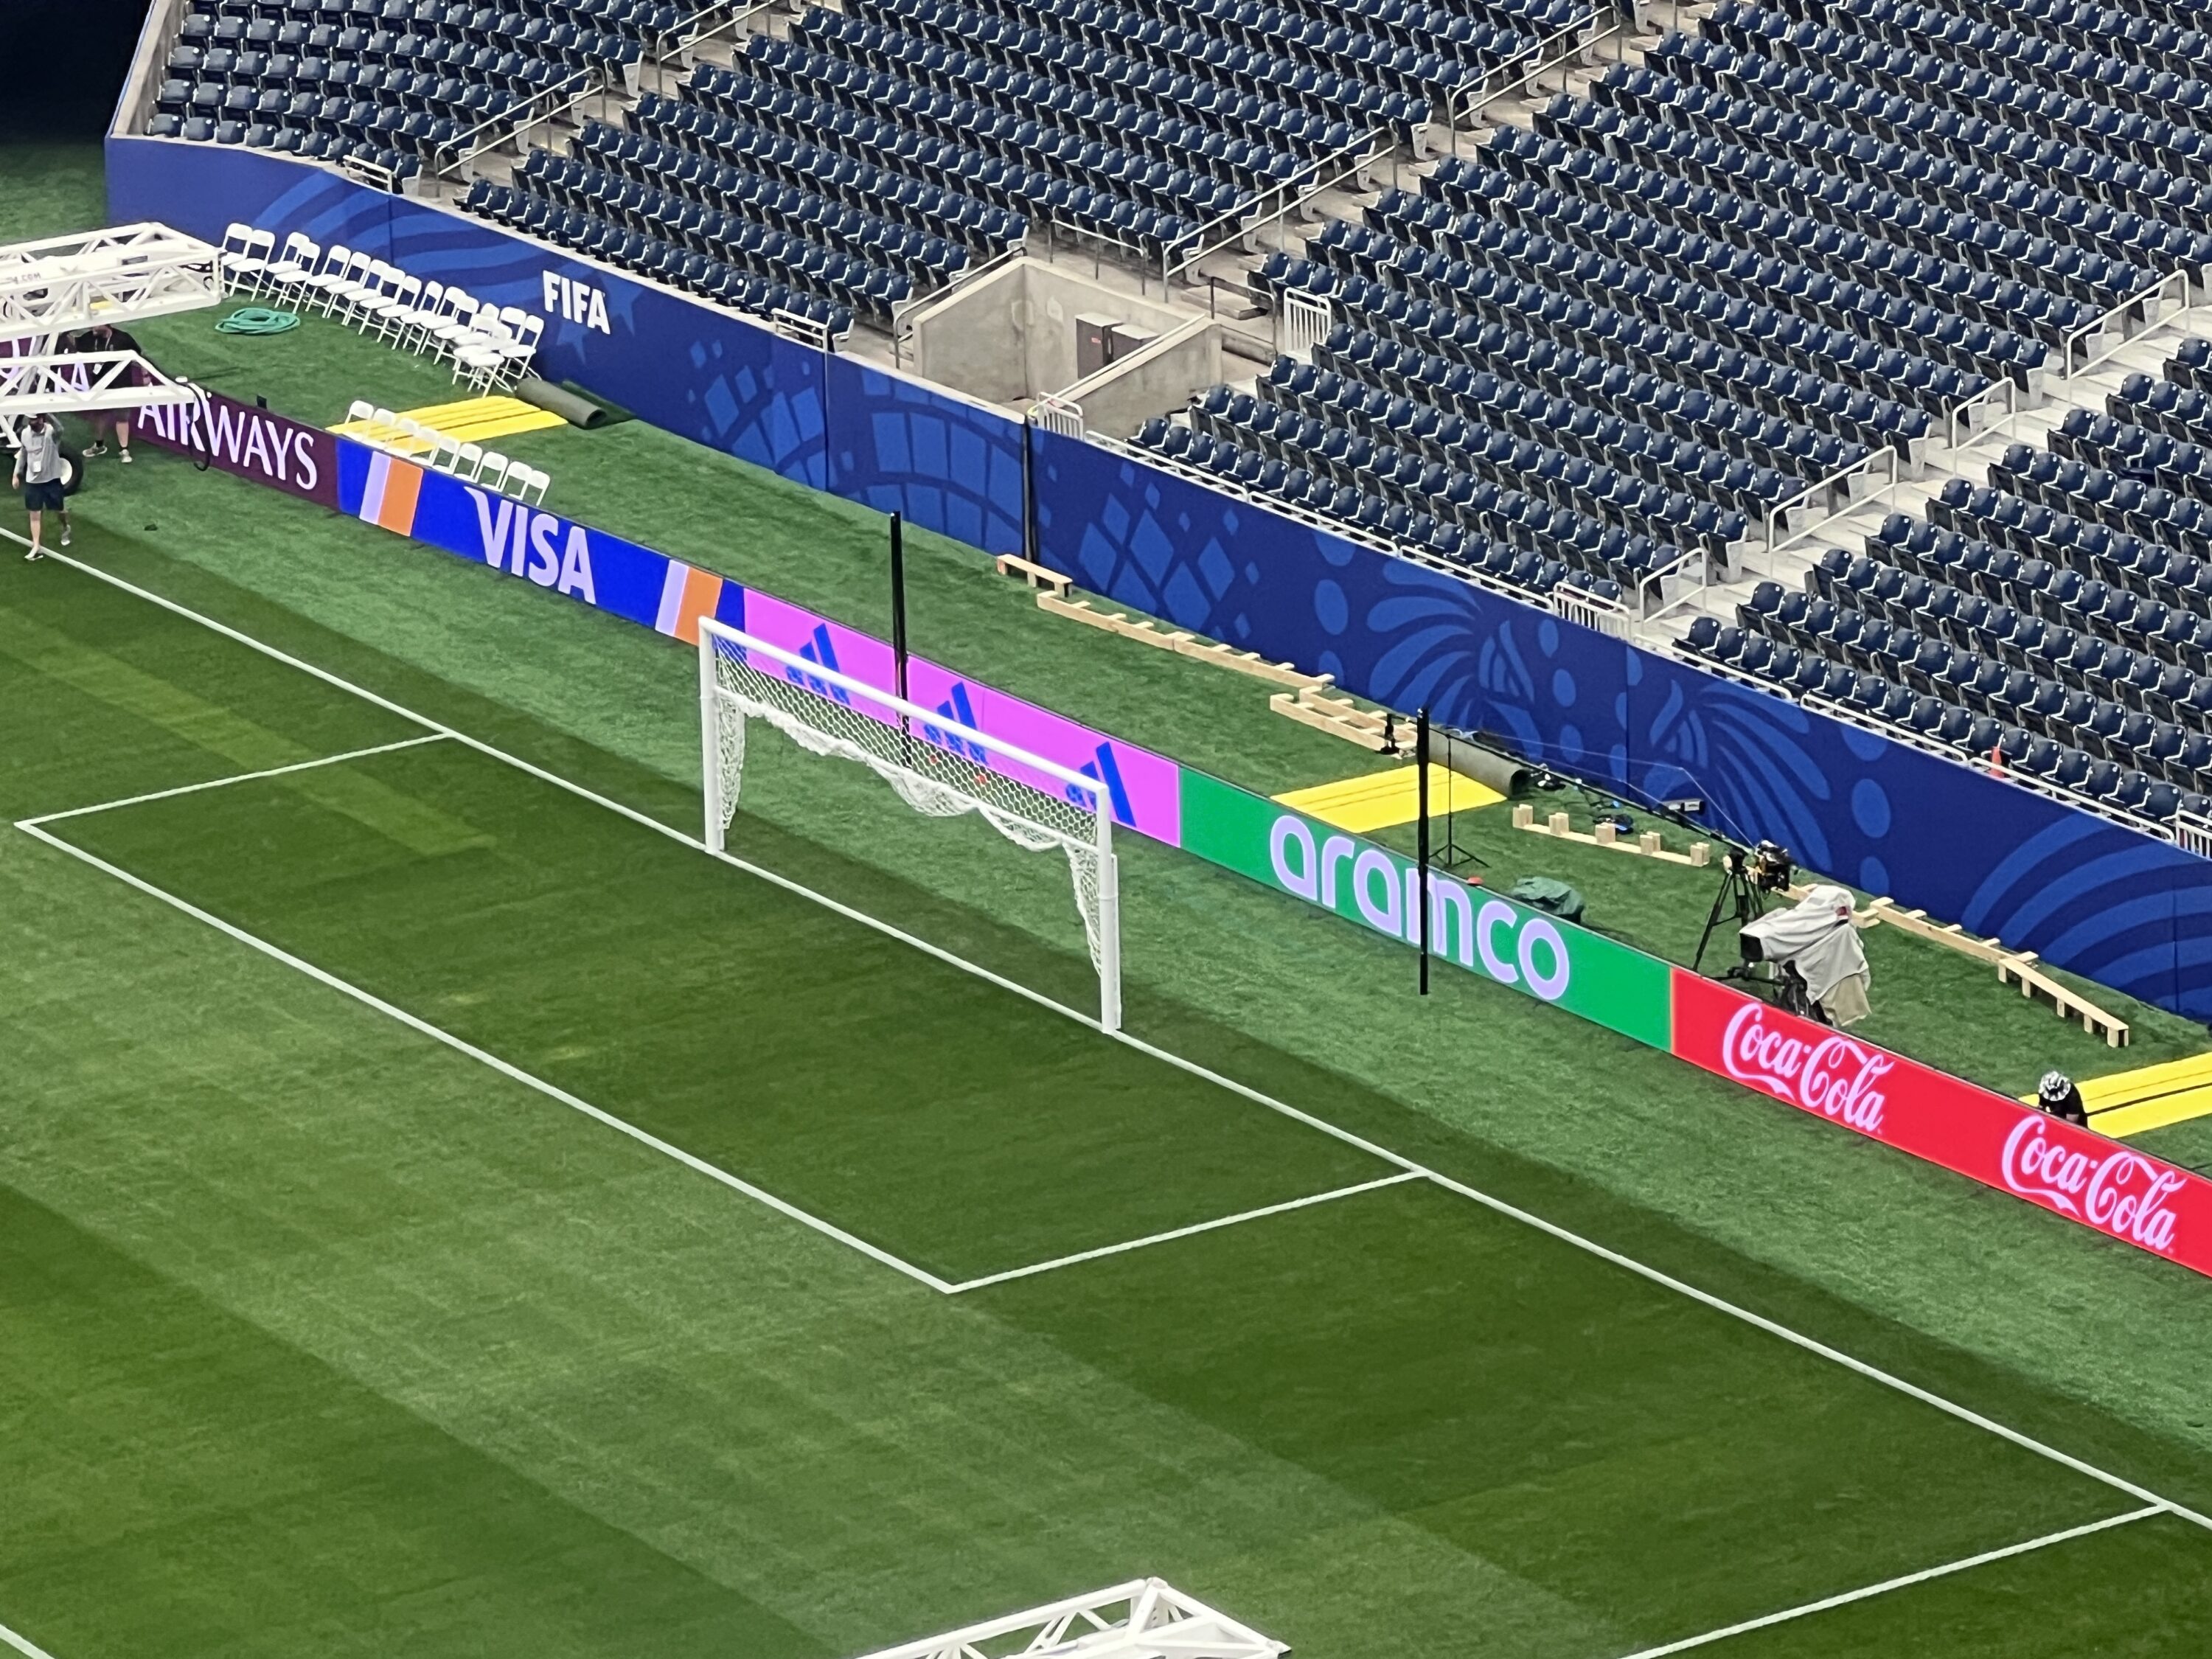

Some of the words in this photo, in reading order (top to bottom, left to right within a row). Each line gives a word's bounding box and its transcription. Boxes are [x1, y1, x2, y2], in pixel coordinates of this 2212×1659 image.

[543, 270, 611, 335] FIFA
[137, 383, 317, 490] AIRWAYS
[463, 486, 604, 605] VISA
[1270, 815, 1570, 1001] aramco
[1722, 1003, 1896, 1133] Coca-Cola
[2002, 1115, 2188, 1251] Coca-Cola
